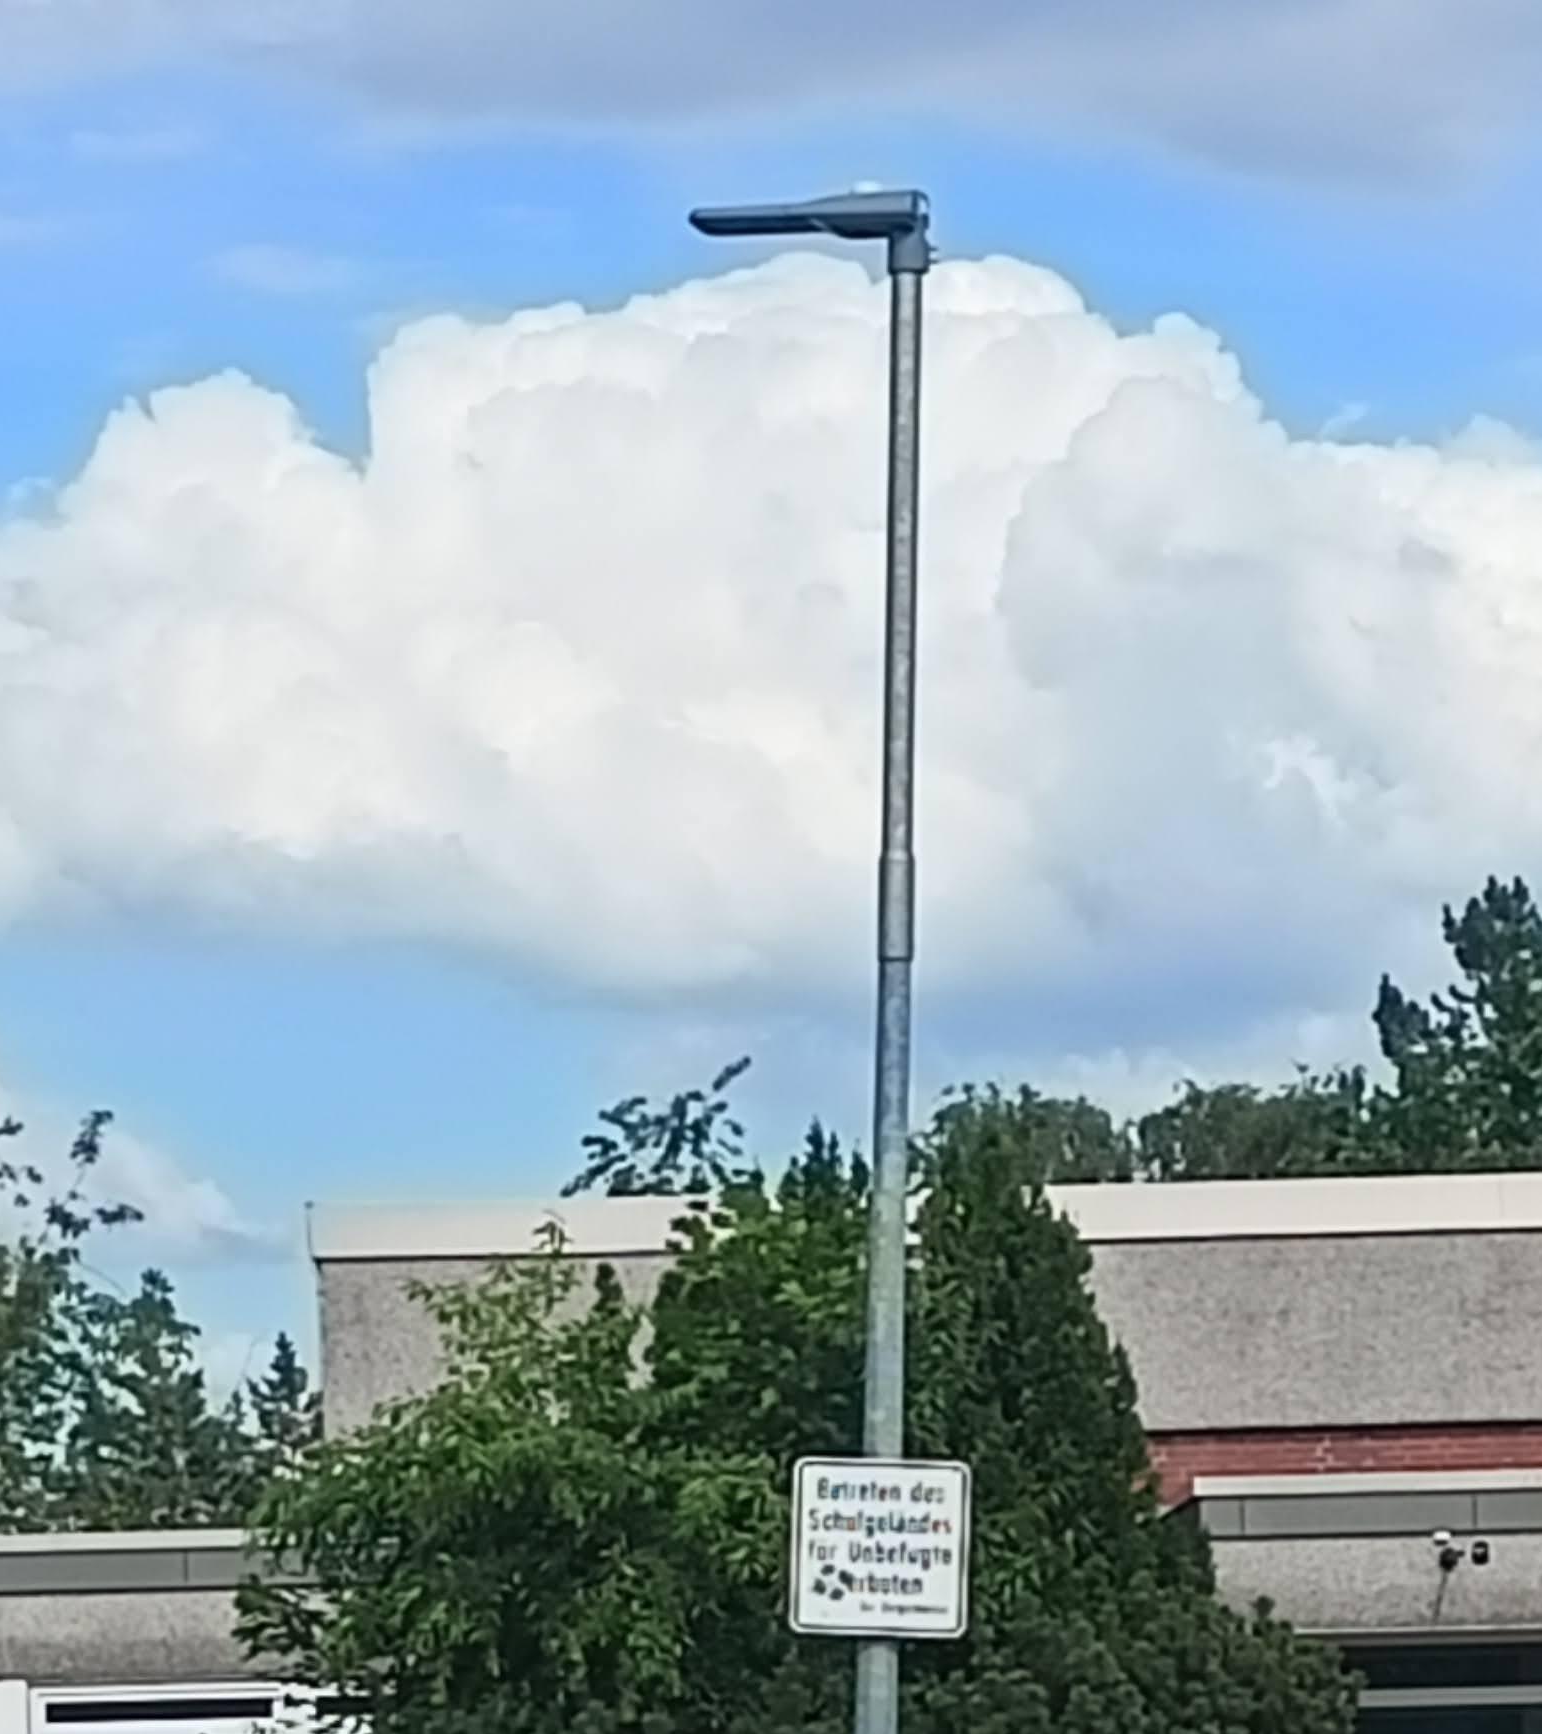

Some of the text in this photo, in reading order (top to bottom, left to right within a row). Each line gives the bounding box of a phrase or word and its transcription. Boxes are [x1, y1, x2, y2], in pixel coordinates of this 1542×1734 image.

[817, 1477, 945, 1503] Betreten des
[808, 1508, 952, 1538] Schulgeländes
[849, 1541, 952, 1571] Unbefugte
